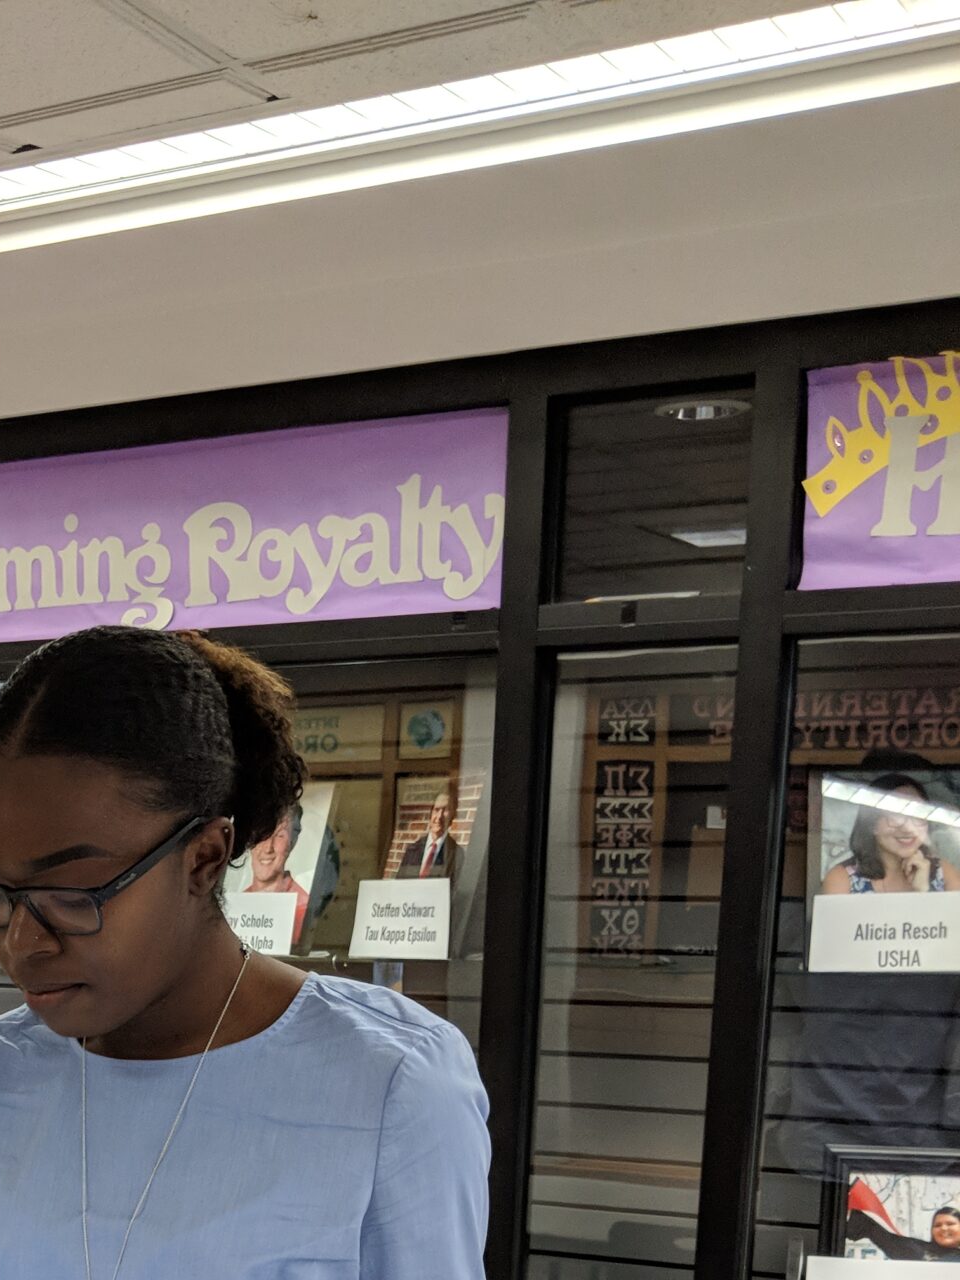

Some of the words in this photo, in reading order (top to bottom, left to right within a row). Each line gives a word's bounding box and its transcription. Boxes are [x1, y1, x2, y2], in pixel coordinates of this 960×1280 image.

[183, 473, 506, 615] Royalty
[371, 902, 401, 918] Steffen
[401, 902, 435, 919] Schwarz
[240, 913, 274, 929] Scholes
[365, 926, 379, 942] Tau
[380, 926, 406, 943] Kappa
[407, 926, 437, 944] Epsilon
[853, 922, 897, 941] Alicia
[902, 920, 948, 940] Resch
[251, 935, 274, 952] Alpha
[878, 950, 921, 968] USHA
